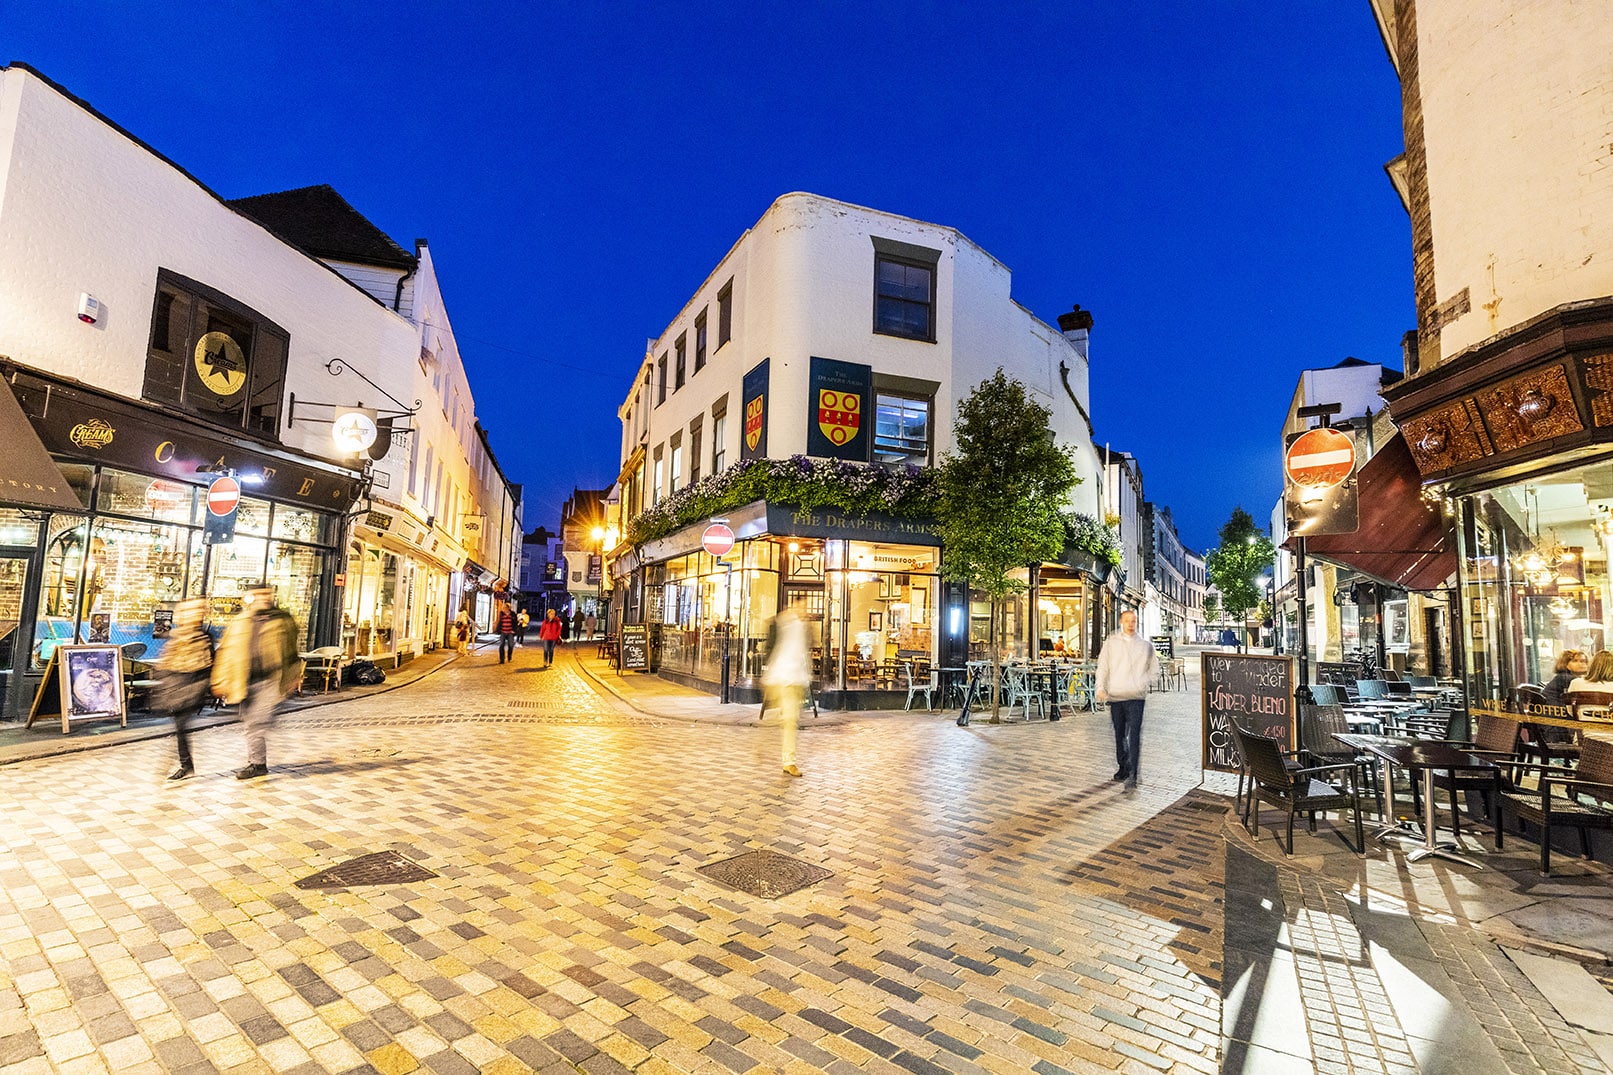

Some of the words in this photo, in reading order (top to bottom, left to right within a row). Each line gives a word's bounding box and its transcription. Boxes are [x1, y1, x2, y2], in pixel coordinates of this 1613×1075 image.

[790, 511, 820, 526] THE
[825, 514, 890, 531] DRAPERS
[874, 555, 899, 564] BRITISH
[899, 558, 917, 567] FOOD
[1211, 671, 1223, 682] to
[1251, 694, 1286, 716] BUENO
[1527, 703, 1568, 718] COFFEE
